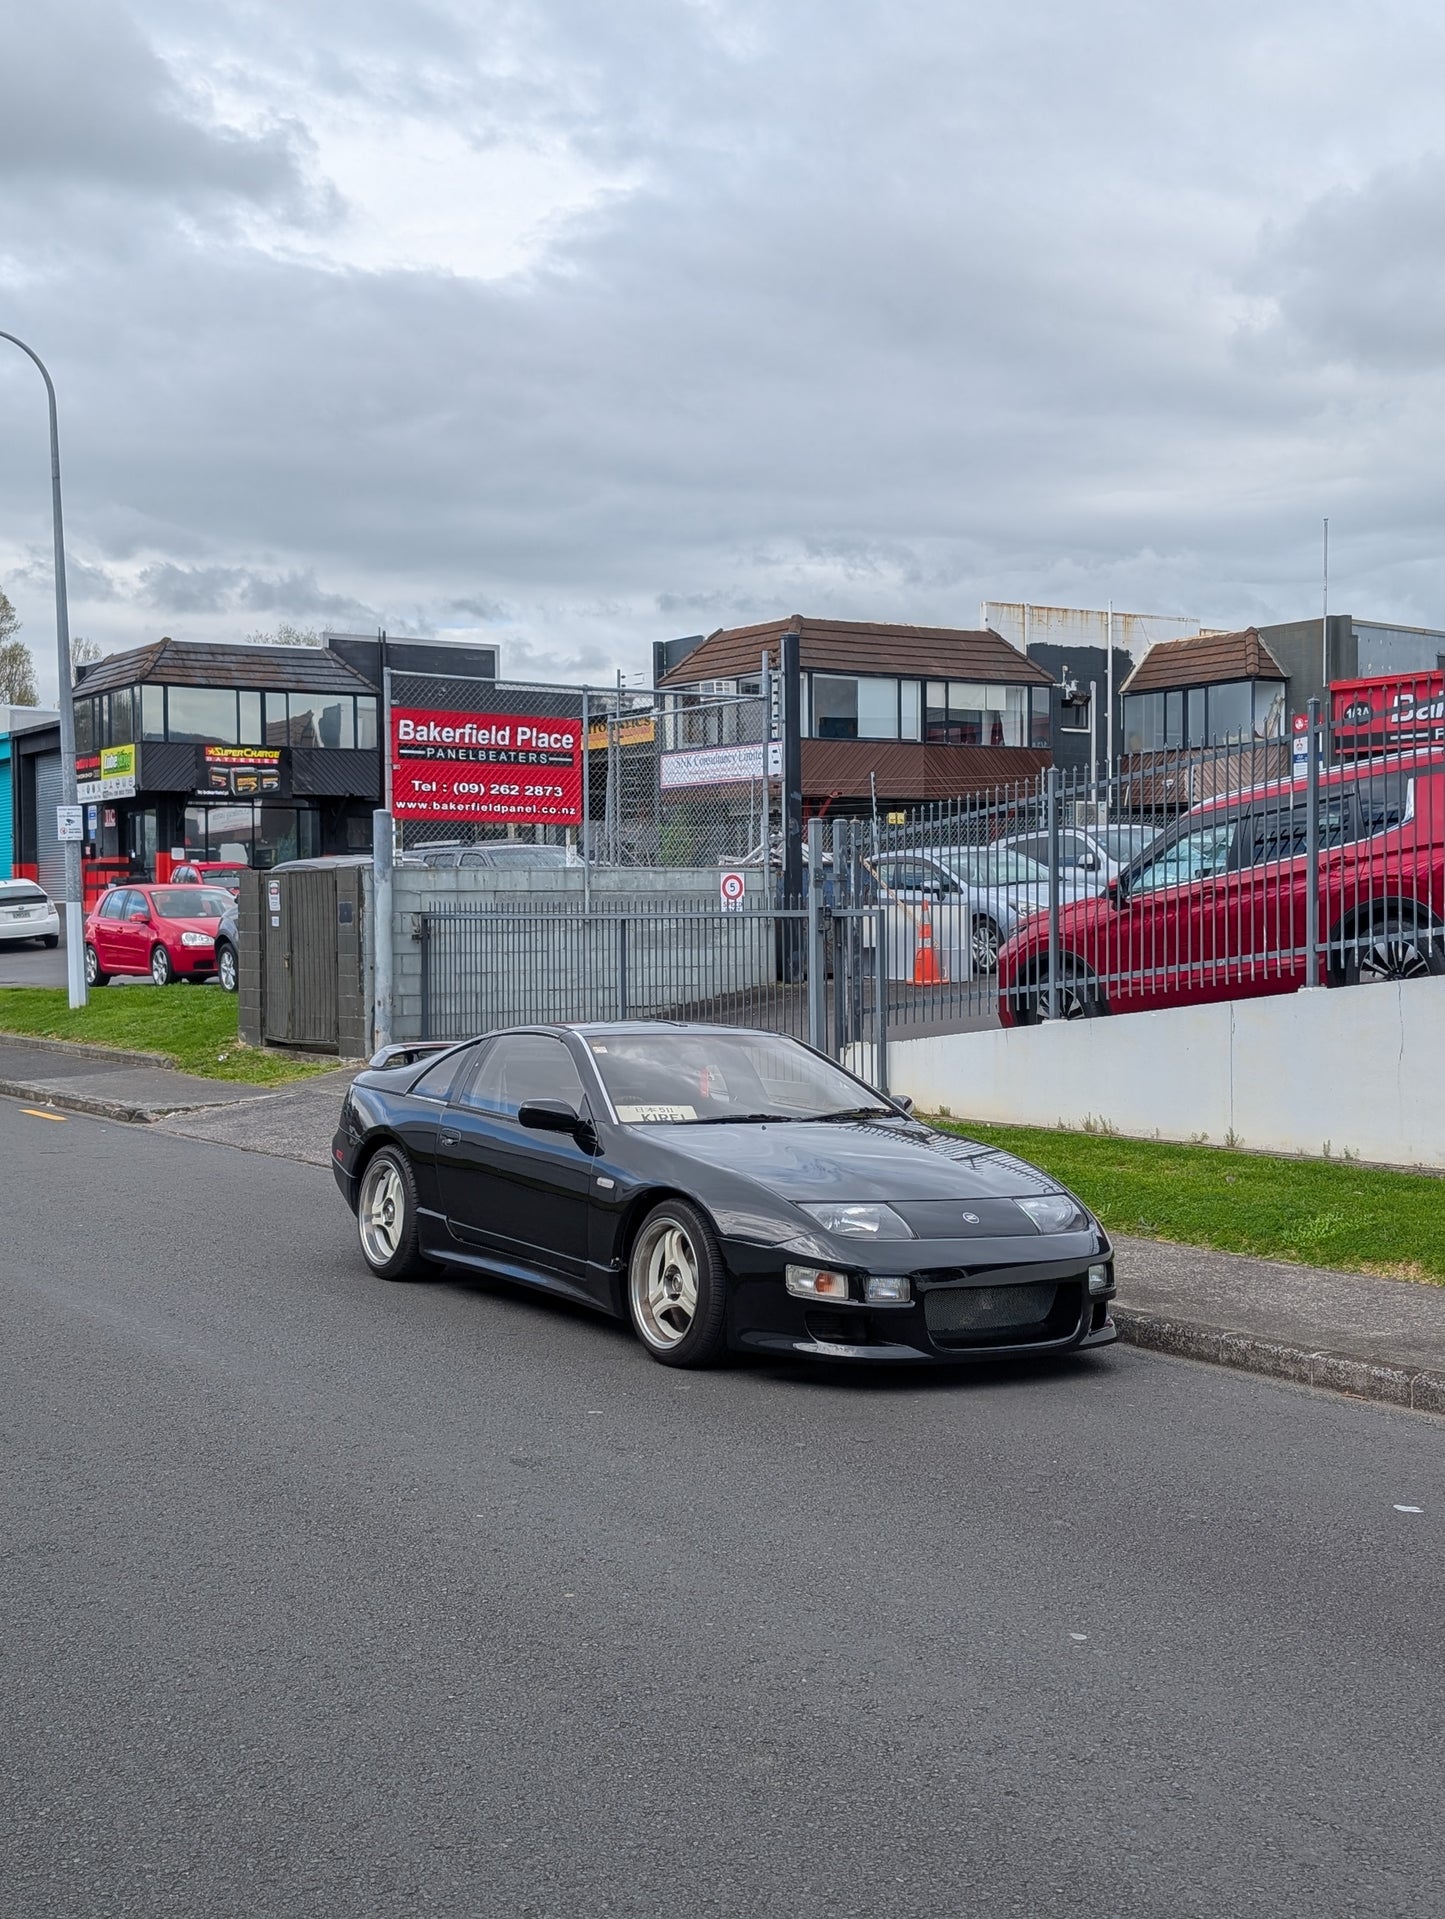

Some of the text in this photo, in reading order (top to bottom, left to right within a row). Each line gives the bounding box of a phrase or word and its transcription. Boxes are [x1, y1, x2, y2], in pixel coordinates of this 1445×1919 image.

[398, 719, 574, 749] Bakerfield Place
[205, 756, 279, 764] BATTERIES
[426, 748, 548, 764] PANELBEATERS
[411, 780, 436, 792] Tel
[453, 782, 485, 795] (09)
[489, 784, 520, 796] 262
[524, 785, 563, 797] 2873
[395, 801, 576, 815] www.bakerfieldpanel.co.nz
[729, 882, 736, 892] 5
